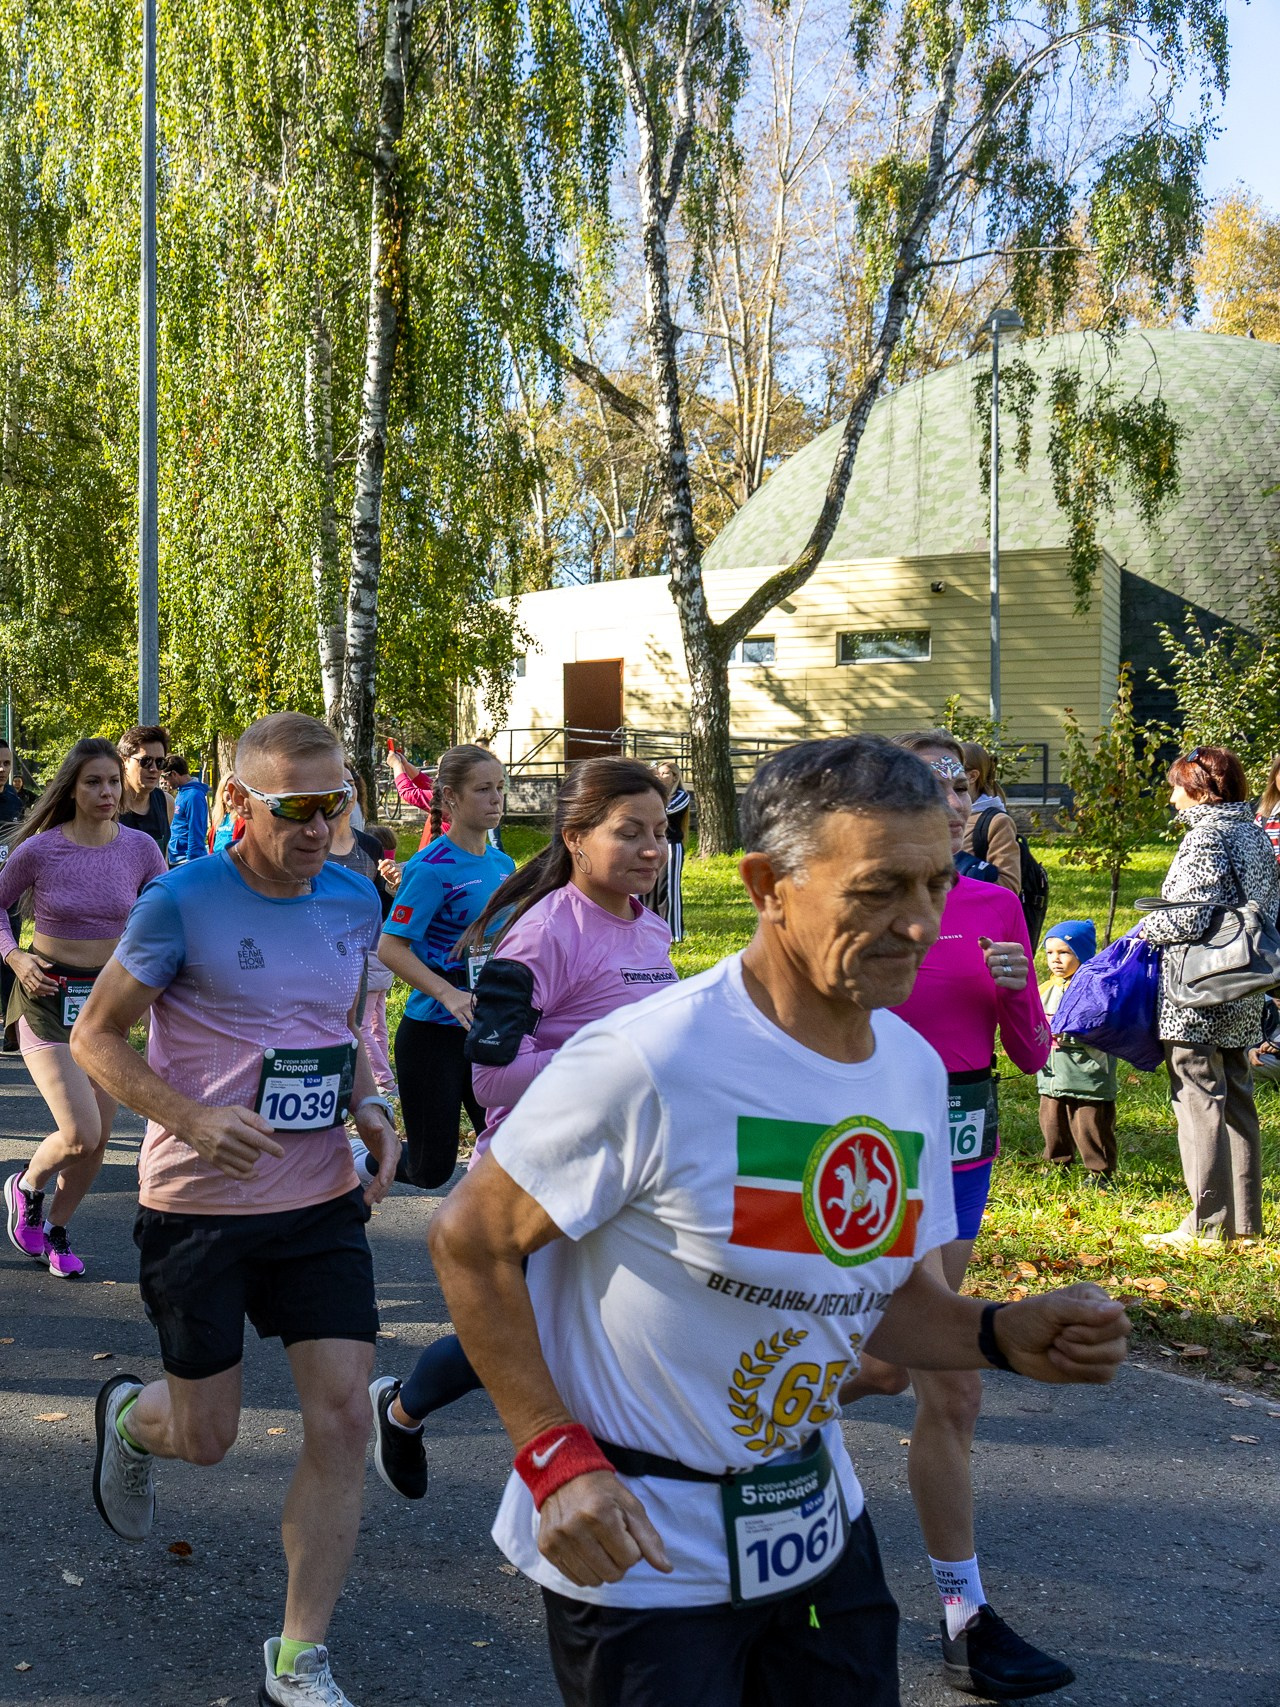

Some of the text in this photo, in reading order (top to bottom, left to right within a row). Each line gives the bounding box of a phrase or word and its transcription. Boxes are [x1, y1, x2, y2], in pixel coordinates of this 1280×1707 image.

[237, 949, 263, 959] БЕЛЫЕ
[239, 957, 266, 967] НОЧИ
[624, 971, 653, 984] running
[282, 1065, 319, 1073] городов
[265, 1090, 336, 1122] 1039
[707, 1272, 817, 1313] ВЕТЕРАНЫ
[814, 1286, 867, 1317] ЛЕГКОЙ
[757, 1481, 787, 1492] серия
[758, 1479, 819, 1505] городов
[746, 1496, 839, 1583] 1067
[935, 1569, 954, 1577] ЭТА
[942, 1595, 962, 1605] СЁ!
